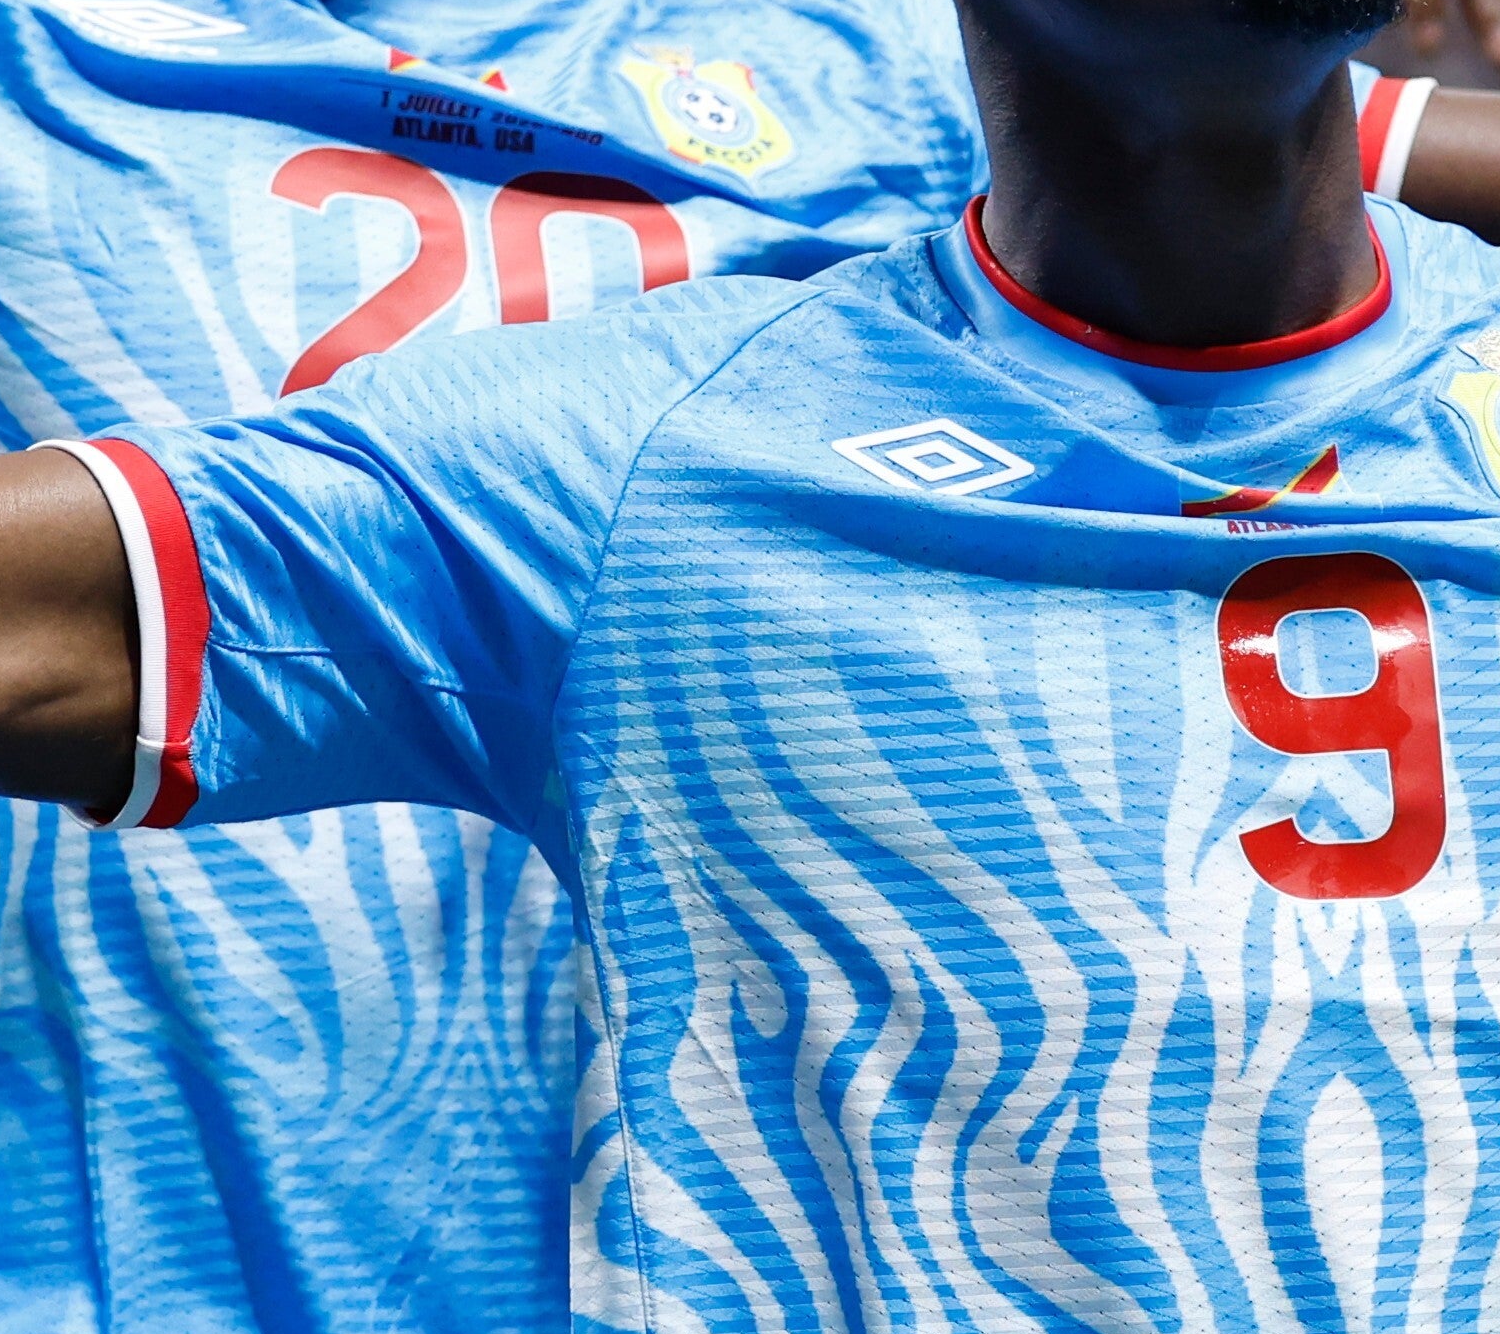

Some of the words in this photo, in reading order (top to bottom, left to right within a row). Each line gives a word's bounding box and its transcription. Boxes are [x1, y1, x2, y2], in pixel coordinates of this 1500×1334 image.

[398, 92, 483, 119] JUILLET
[494, 126, 535, 153] USA
[271, 147, 691, 399] 20
[1216, 553, 1448, 901] 9
